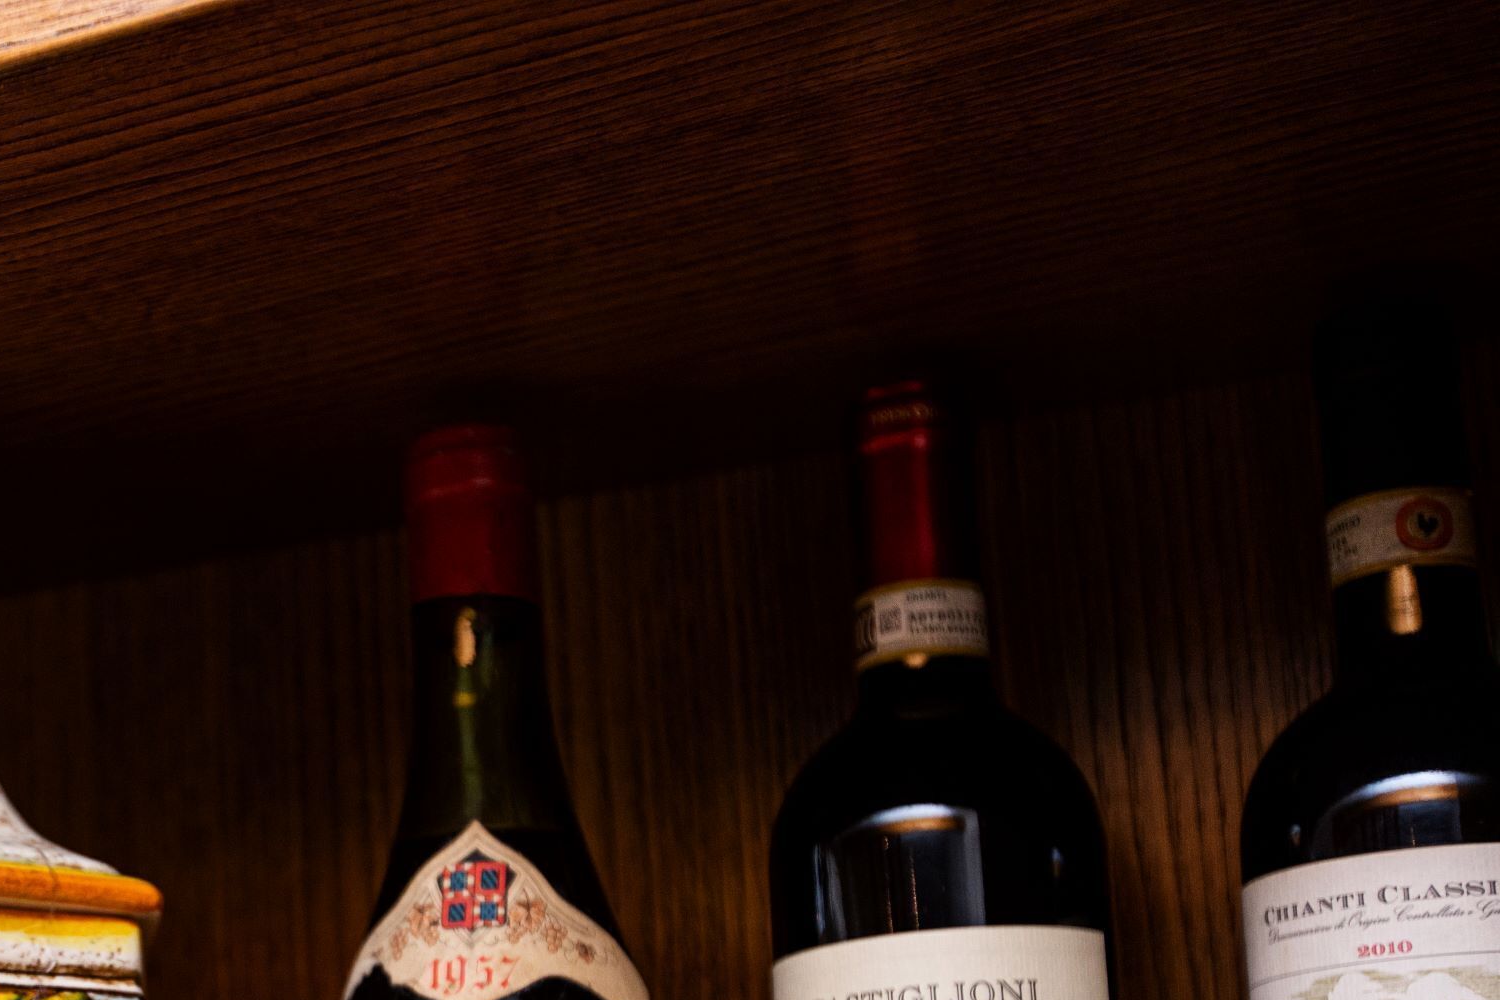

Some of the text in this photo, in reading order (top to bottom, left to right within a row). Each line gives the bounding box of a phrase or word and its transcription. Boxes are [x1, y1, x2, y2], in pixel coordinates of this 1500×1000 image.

[1264, 892, 1365, 927] CHIANTI
[1357, 940, 1413, 957] 2010
[431, 954, 520, 994] 1957
